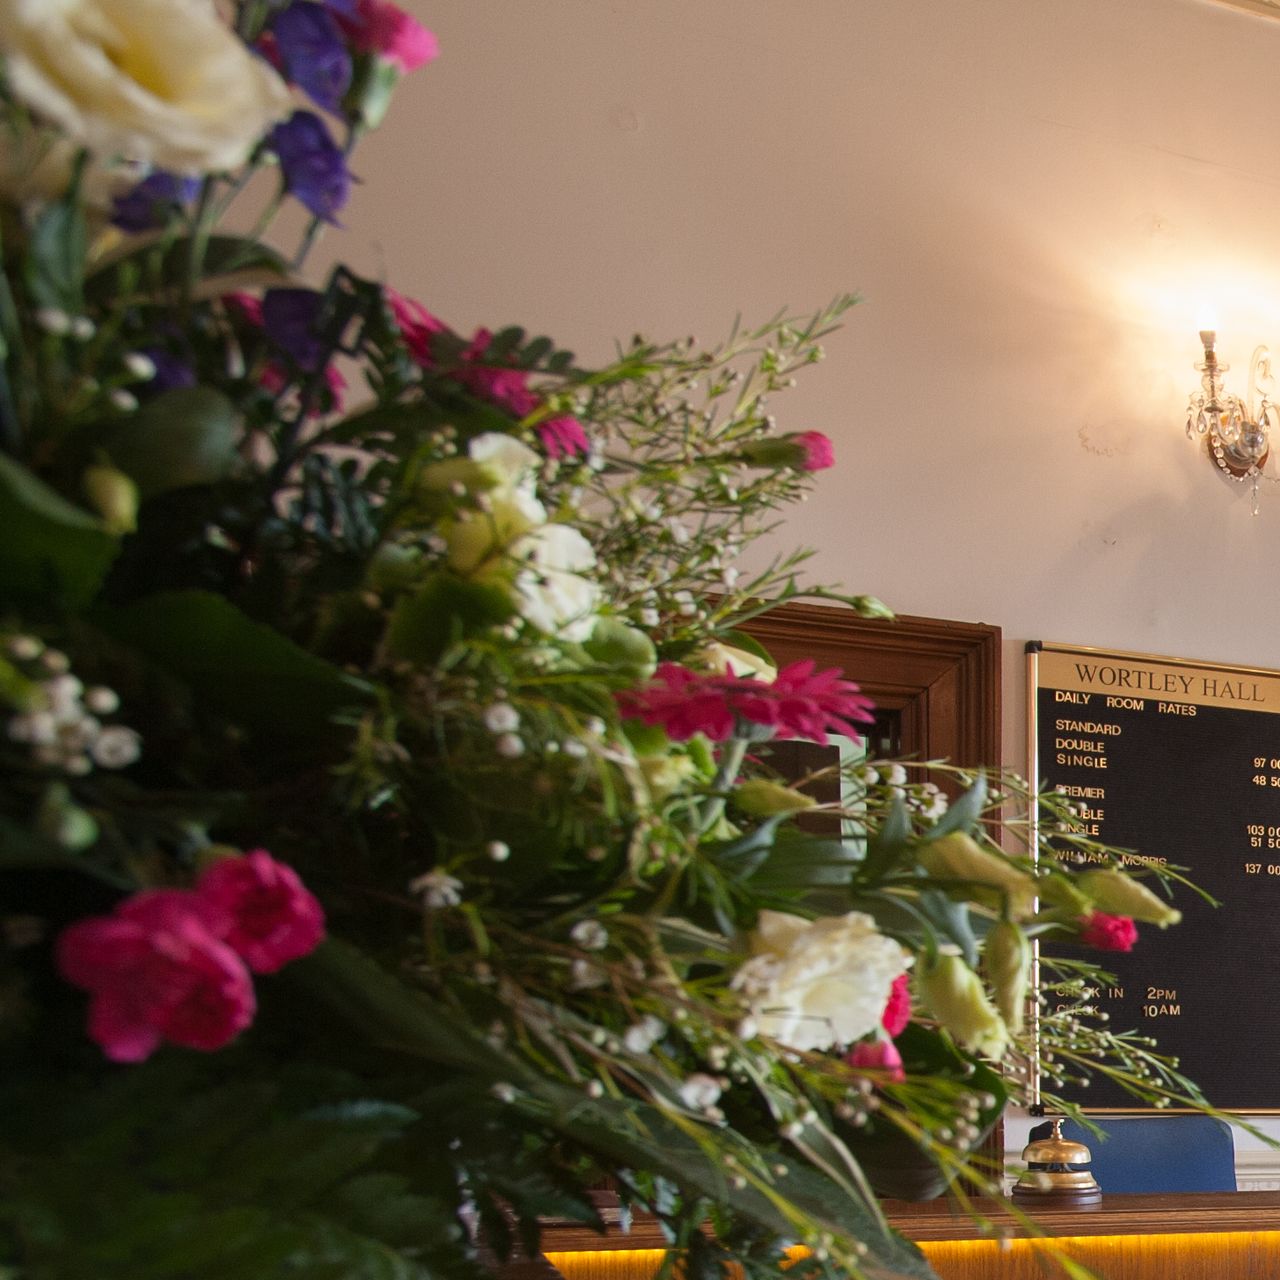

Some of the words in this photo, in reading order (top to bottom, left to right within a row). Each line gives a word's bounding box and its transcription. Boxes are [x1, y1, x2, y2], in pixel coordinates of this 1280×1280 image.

[1075, 663, 1195, 694] WORTLEY
[1203, 678, 1265, 702] HALL
[1055, 691, 1091, 705] DAILY
[1106, 697, 1144, 711] ROOM
[1158, 702, 1197, 717] RATES
[1055, 719, 1121, 736] STANDARD
[1055, 738, 1105, 753] DOUBLE
[1253, 757, 1266, 768] 97
[1056, 754, 1107, 769] SINGLE
[1252, 775, 1266, 786] 48
[1247, 825, 1265, 836] 103
[1250, 837, 1262, 848] 51
[1245, 863, 1262, 874] 137
[1108, 988, 1124, 998] IN
[1147, 986, 1176, 1000] 2PM
[1143, 1004, 1181, 1018] 10AM
